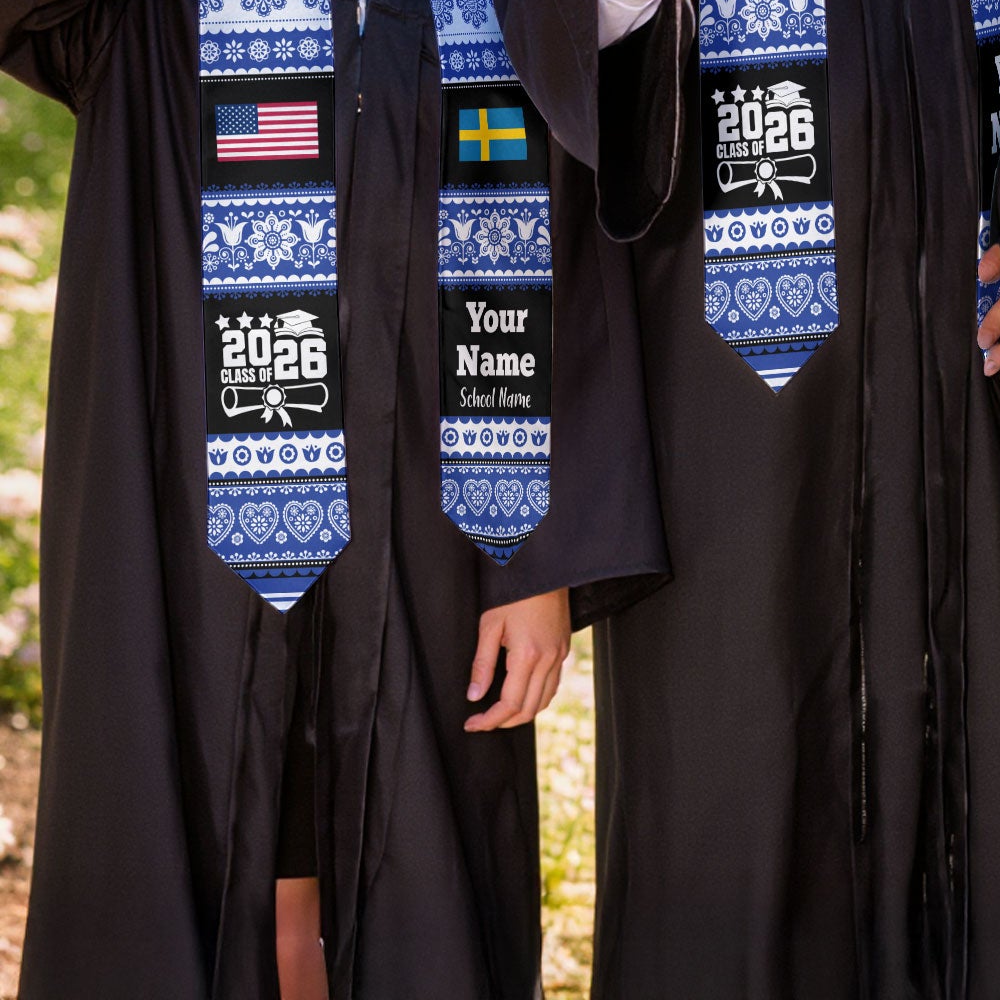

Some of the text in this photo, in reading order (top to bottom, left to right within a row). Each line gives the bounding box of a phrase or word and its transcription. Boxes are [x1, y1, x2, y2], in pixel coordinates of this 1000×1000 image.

[717, 101, 816, 154] 2026
[716, 140, 765, 159] CLASS OF
[465, 301, 529, 334] Your
[221, 328, 328, 380] 2026
[456, 344, 536, 378] Name
[220, 366, 273, 384] CLASS OF
[459, 386, 532, 409] School Name
